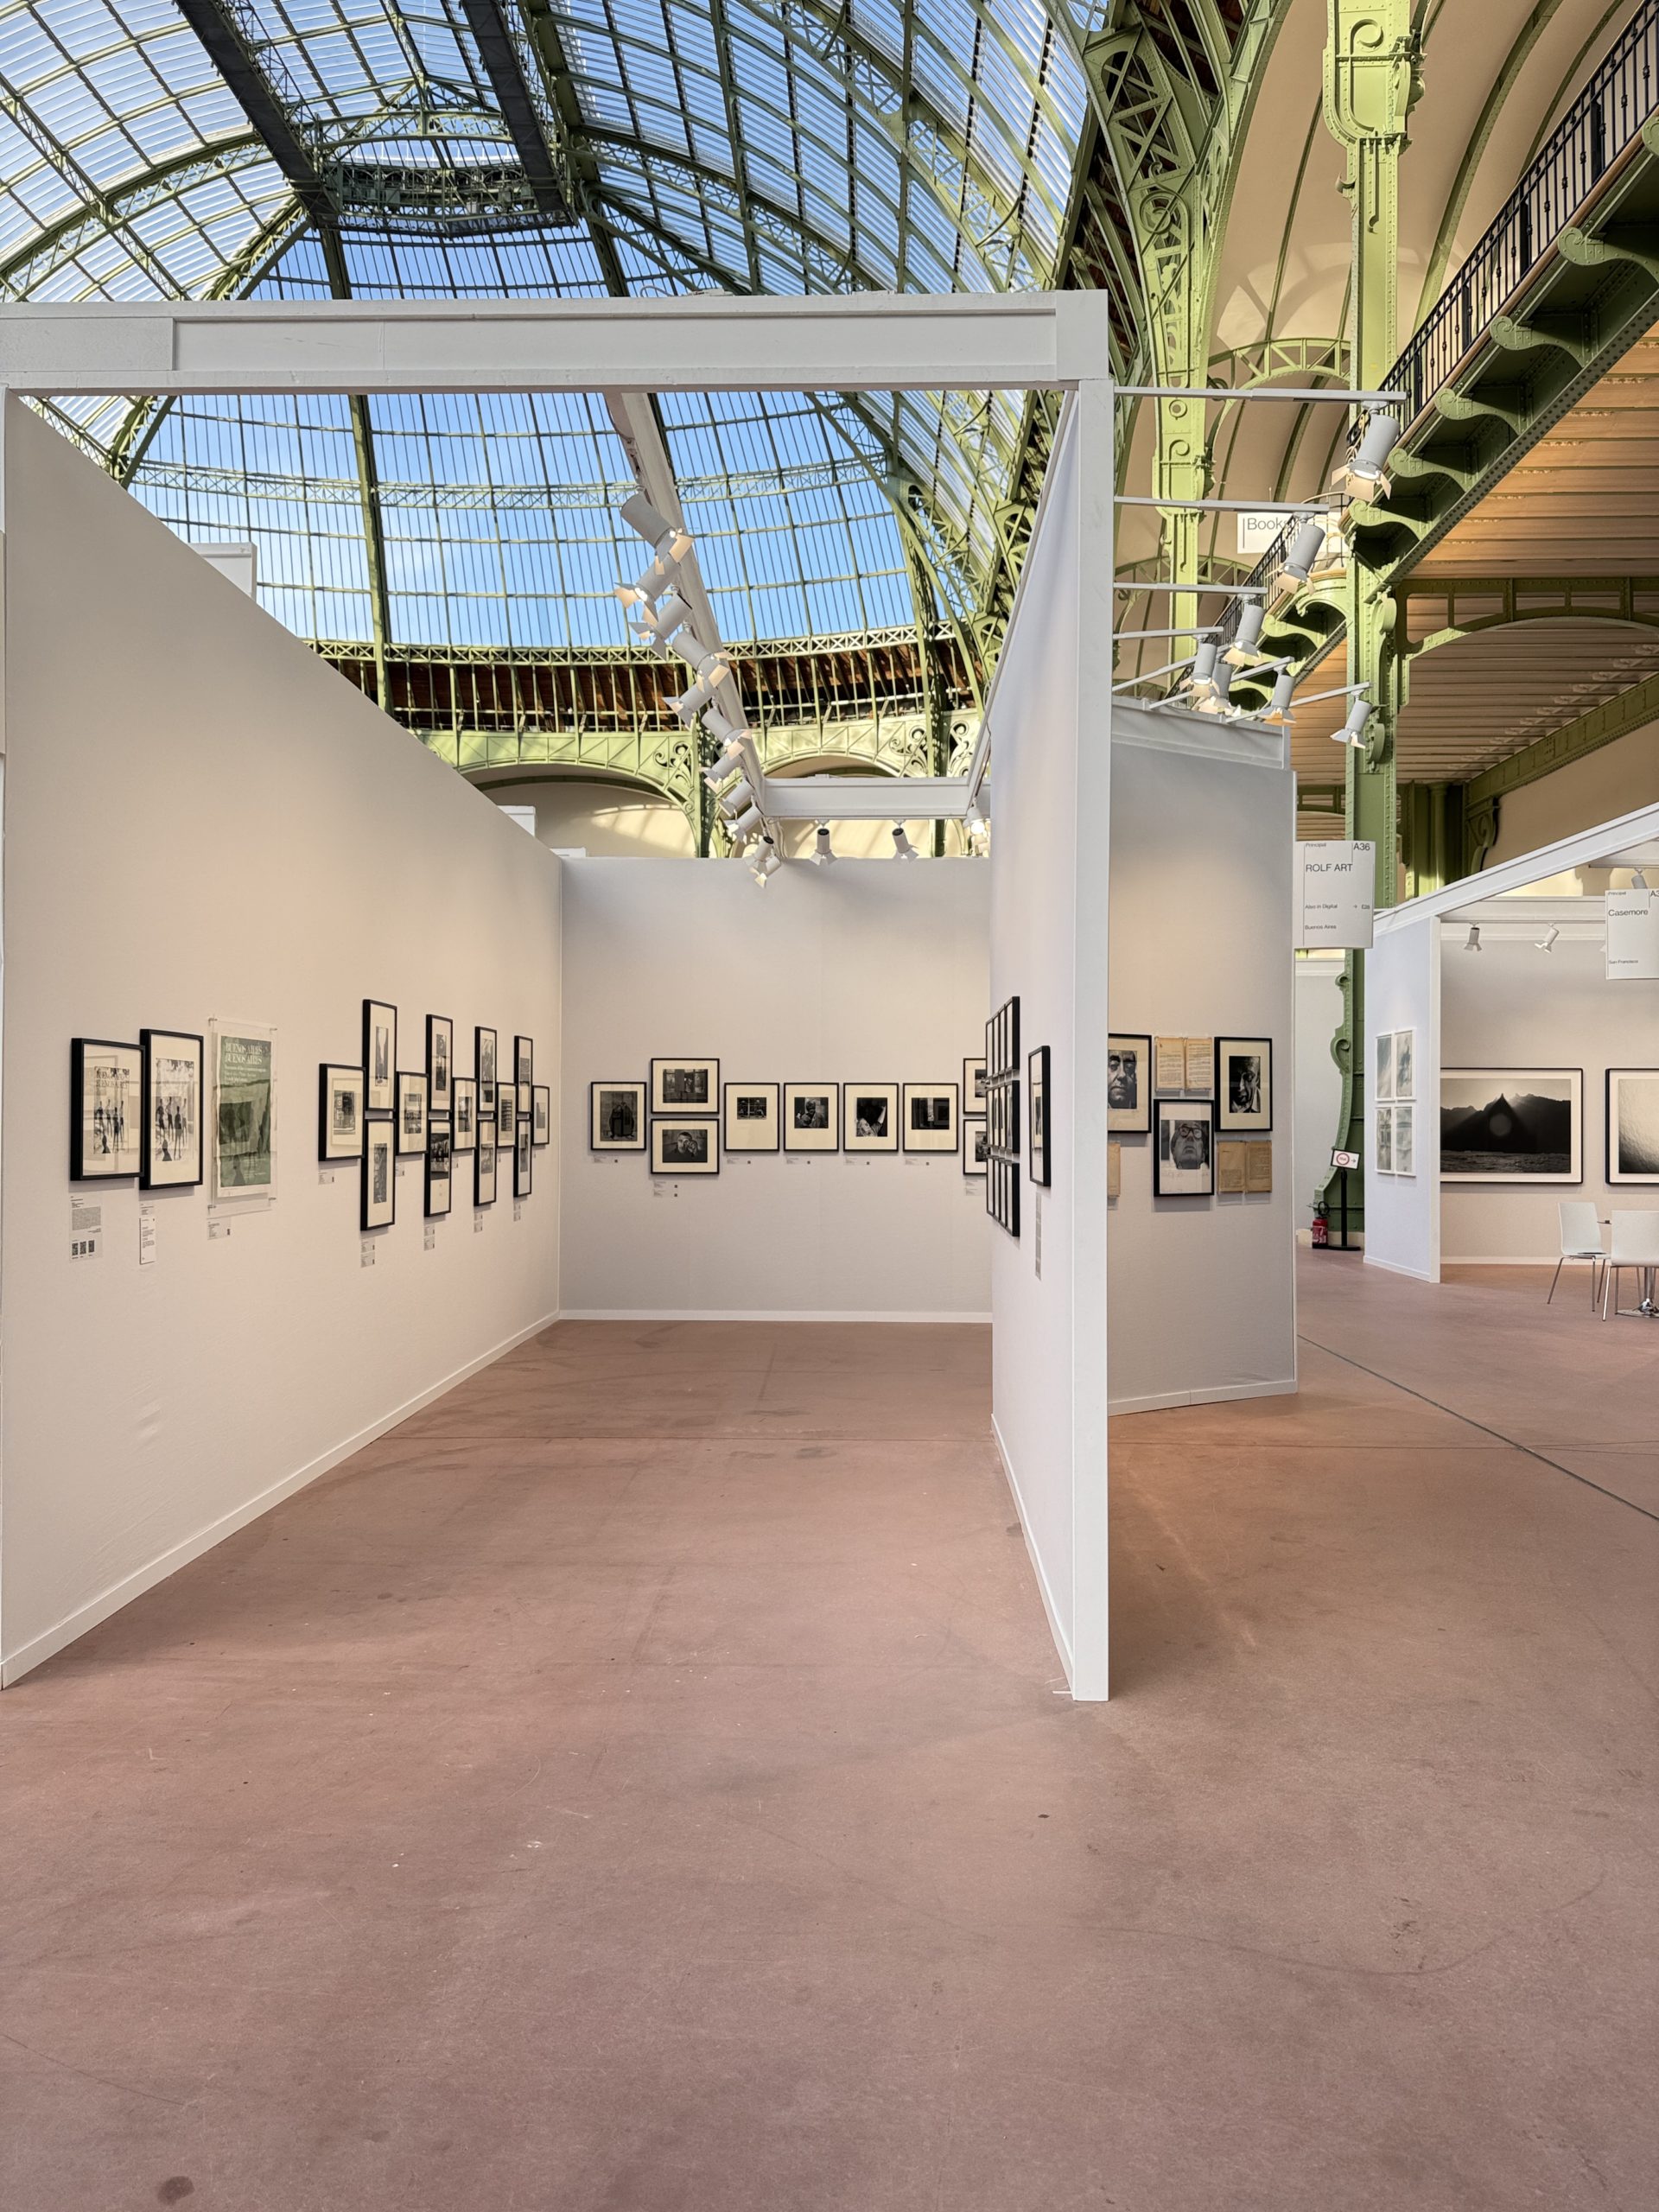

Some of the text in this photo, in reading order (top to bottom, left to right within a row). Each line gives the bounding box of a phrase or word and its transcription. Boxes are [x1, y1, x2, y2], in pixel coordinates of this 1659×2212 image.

[1353, 842, 1370, 851] A36
[1306, 863, 1353, 872] ROLF ART
